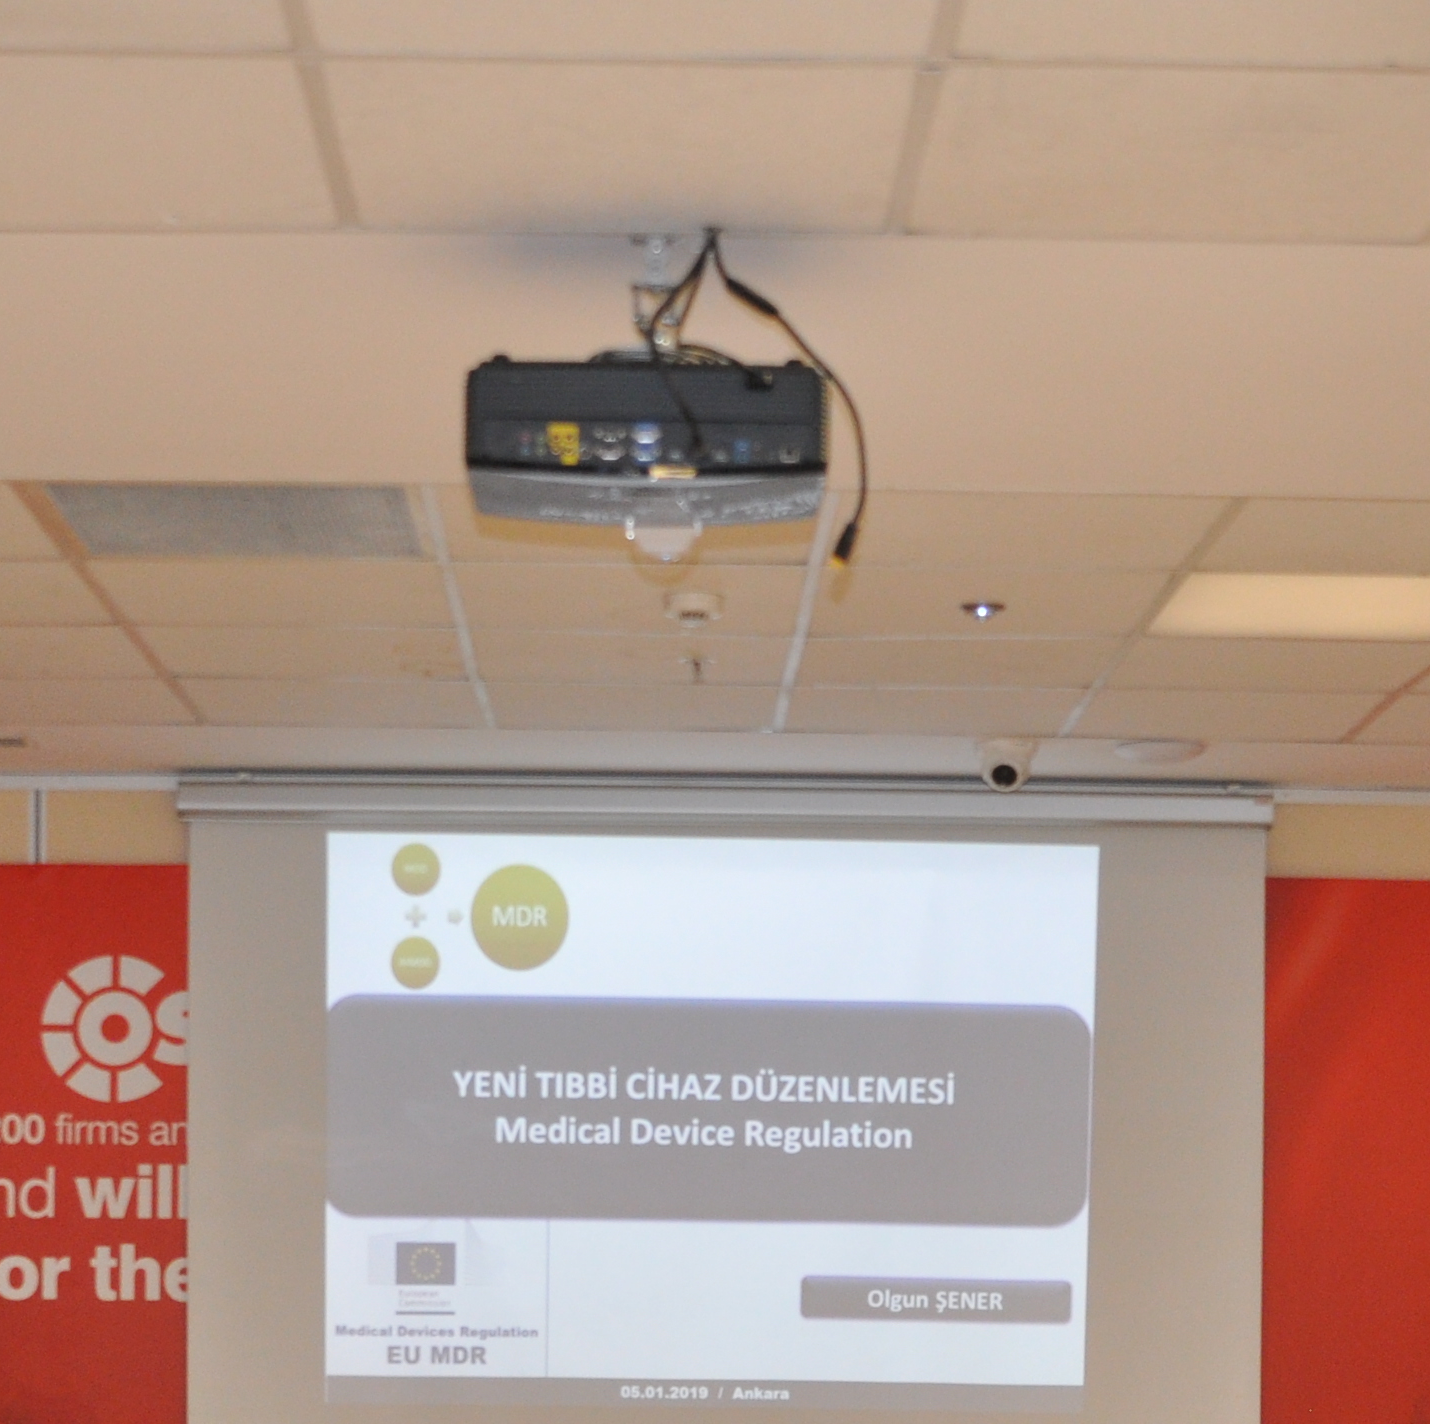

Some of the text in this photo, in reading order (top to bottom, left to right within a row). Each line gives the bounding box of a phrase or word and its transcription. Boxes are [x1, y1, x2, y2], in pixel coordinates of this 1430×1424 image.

[491, 904, 548, 928] MDR
[453, 1065, 527, 1099] YENİ
[625, 1068, 722, 1102] CİHAZ
[730, 1069, 956, 1105] DÜZENLEMESİ
[55, 1115, 139, 1146] firms
[495, 1116, 914, 1153] Medical Device Regulation
[867, 1289, 1004, 1314] Olgun ŞENER
[335, 1325, 539, 1340] Medical Devices Regulation
[387, 1346, 488, 1365] EU MDR
[732, 1387, 790, 1400] Ankara
